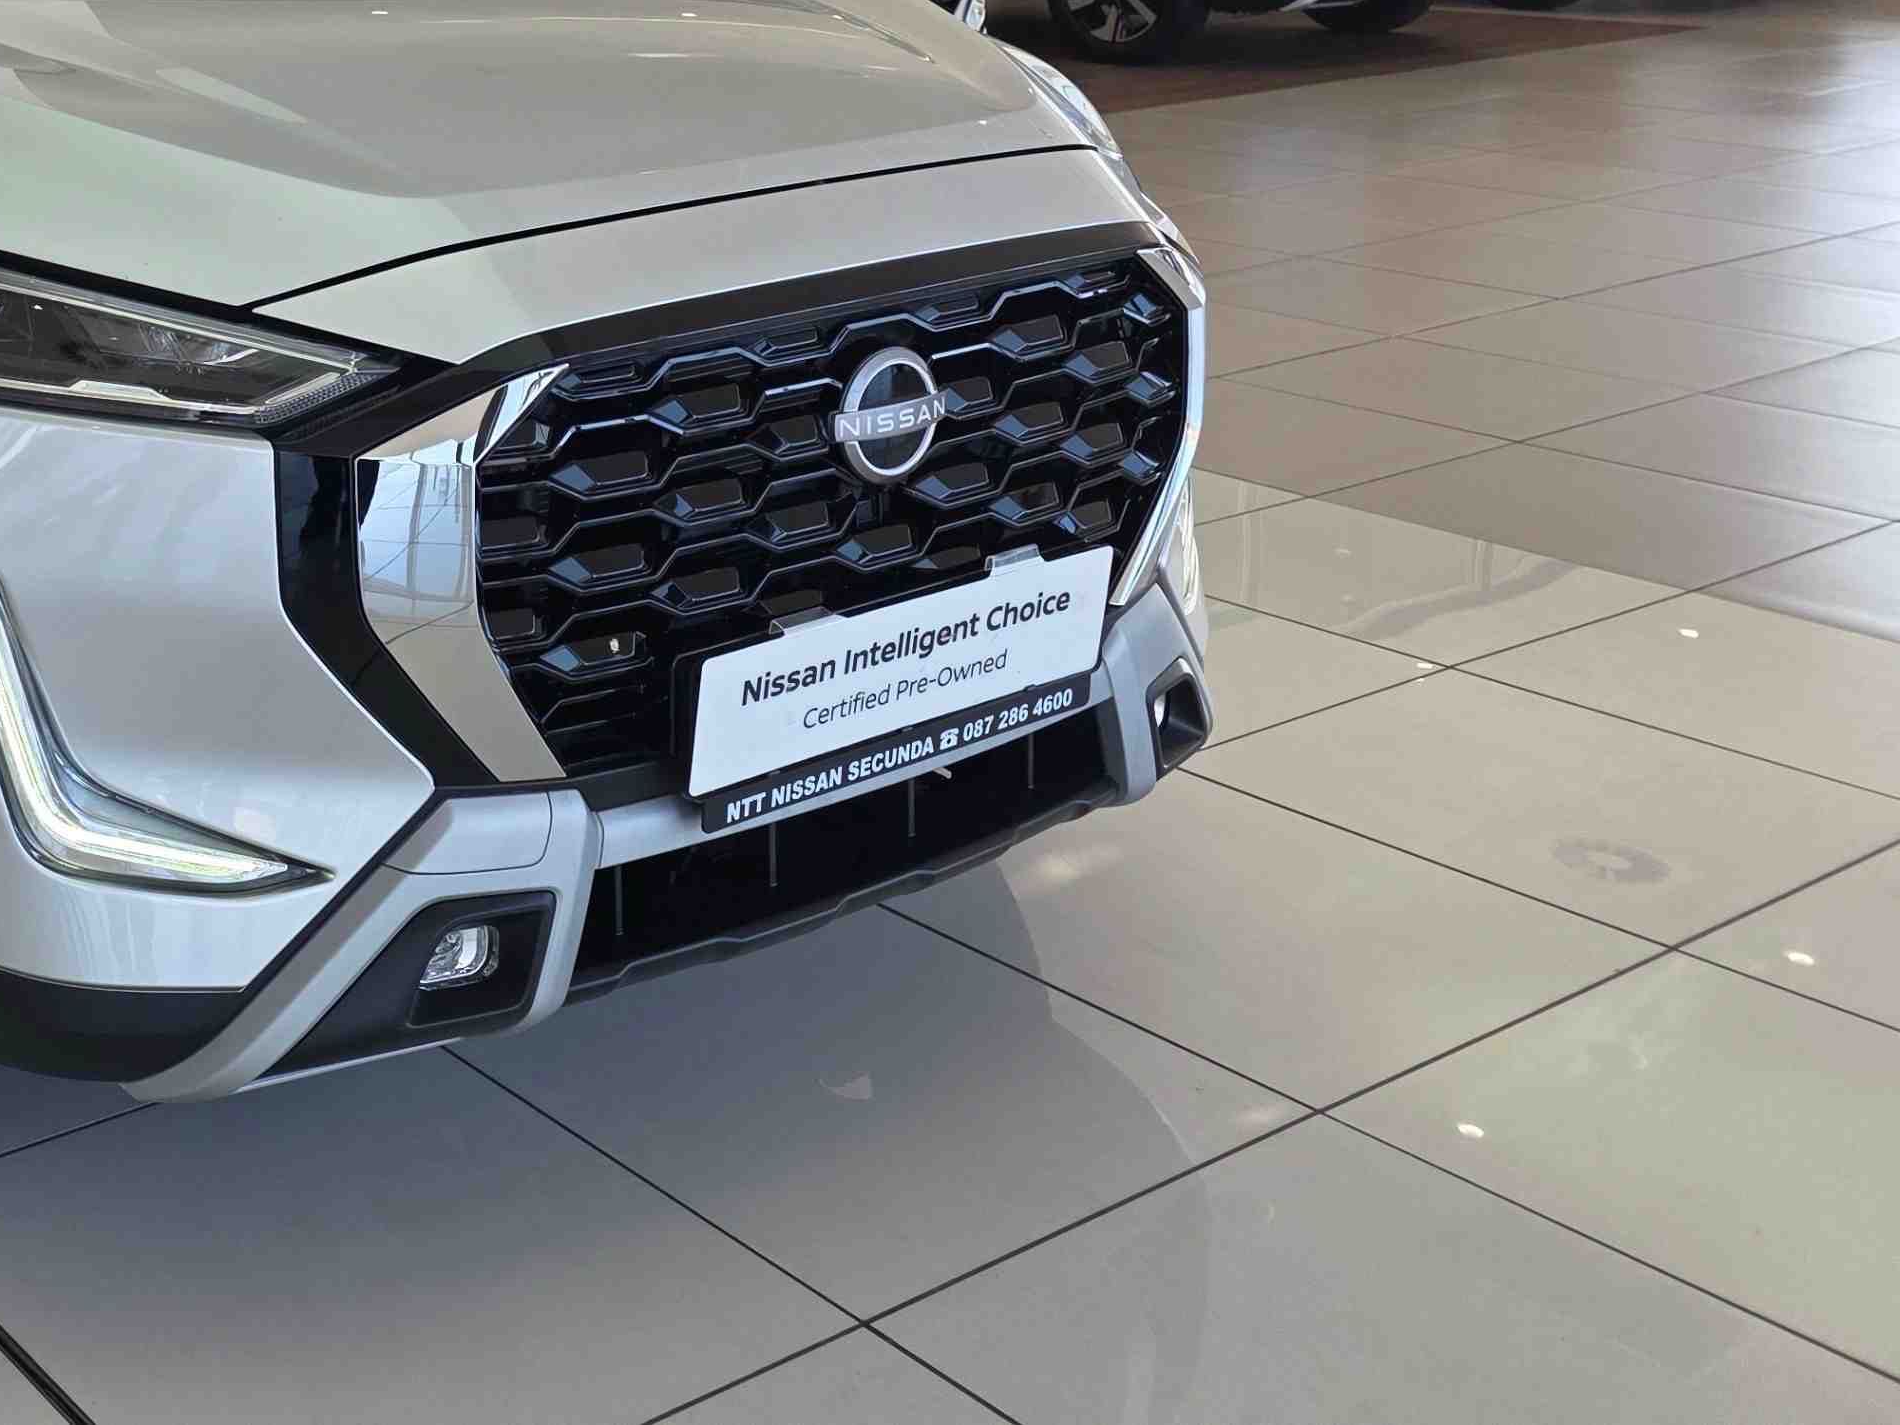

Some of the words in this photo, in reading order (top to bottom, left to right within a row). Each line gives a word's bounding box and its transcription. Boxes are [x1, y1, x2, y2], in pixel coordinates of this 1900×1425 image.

[839, 396, 946, 438] NISSAN
[741, 658, 836, 706] Nissan
[843, 613, 980, 675] Intelligent
[986, 591, 1071, 632] Choice
[803, 683, 891, 729] Certified
[896, 648, 1008, 701] Pre-Owned
[726, 792, 766, 823] NTT
[771, 766, 843, 807] NISSAN
[848, 736, 934, 781] SECUNDA
[963, 715, 994, 742] 087
[999, 704, 1029, 729] 286
[1033, 688, 1073, 716] 4600
